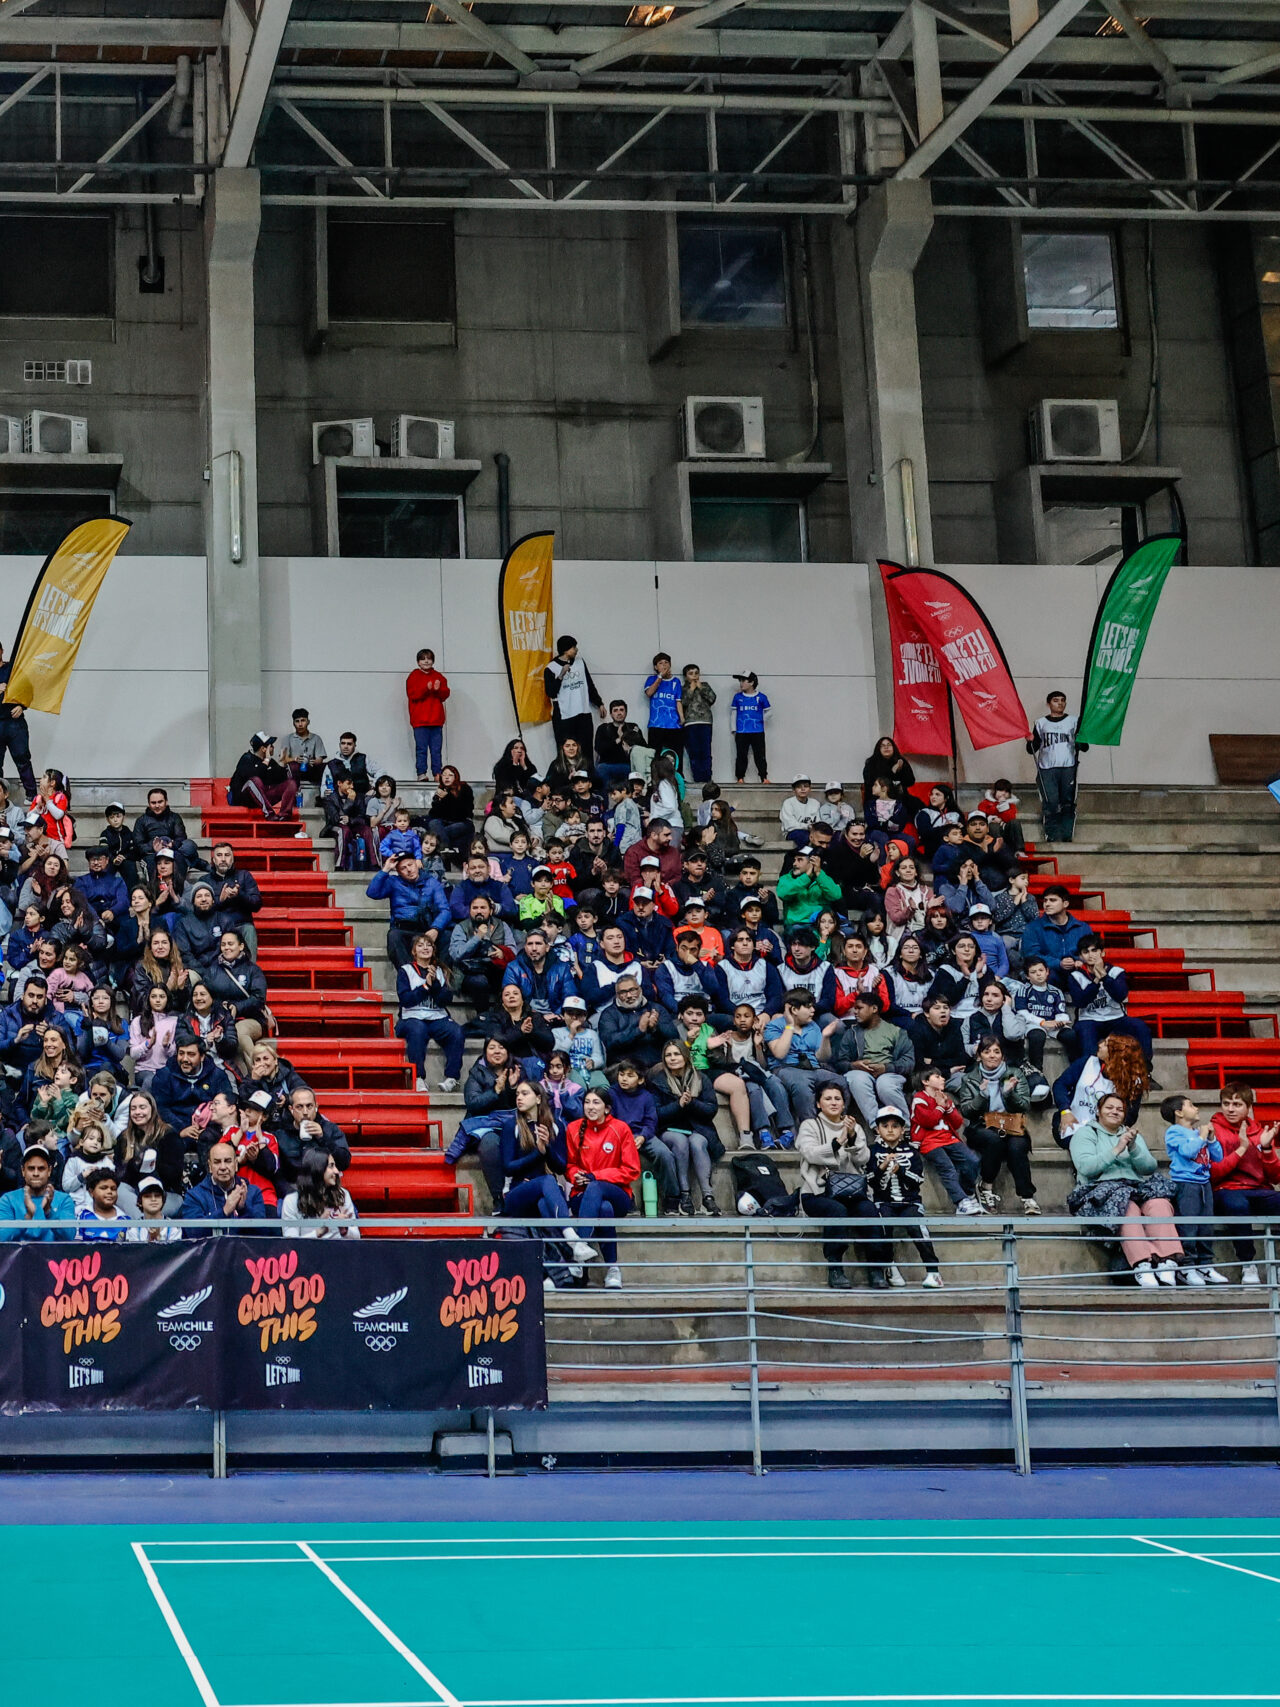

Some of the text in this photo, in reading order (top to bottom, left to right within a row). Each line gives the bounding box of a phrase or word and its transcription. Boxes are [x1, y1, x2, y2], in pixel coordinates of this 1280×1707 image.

[38, 583, 69, 614] LET'S
[509, 610, 534, 634] LET'S
[1100, 621, 1129, 649] LET'S
[659, 692, 674, 700] BICE
[1043, 732, 1059, 748] LET'S
[48, 1251, 100, 1295] YOU
[245, 1250, 297, 1294] YOU
[446, 1251, 499, 1295] YOU
[40, 1274, 129, 1329] CAN DO
[238, 1273, 325, 1328] CAN DO
[439, 1274, 526, 1329] CAN DO
[63, 1309, 121, 1354] THIS
[157, 1321, 214, 1332] TEAMCHILE
[258, 1308, 317, 1353] THIS
[353, 1321, 409, 1333] TEAMCHILE
[461, 1309, 518, 1354] THIS
[69, 1365, 91, 1388] LET'S
[266, 1363, 288, 1387] LET'S
[468, 1364, 490, 1388] LET'S
